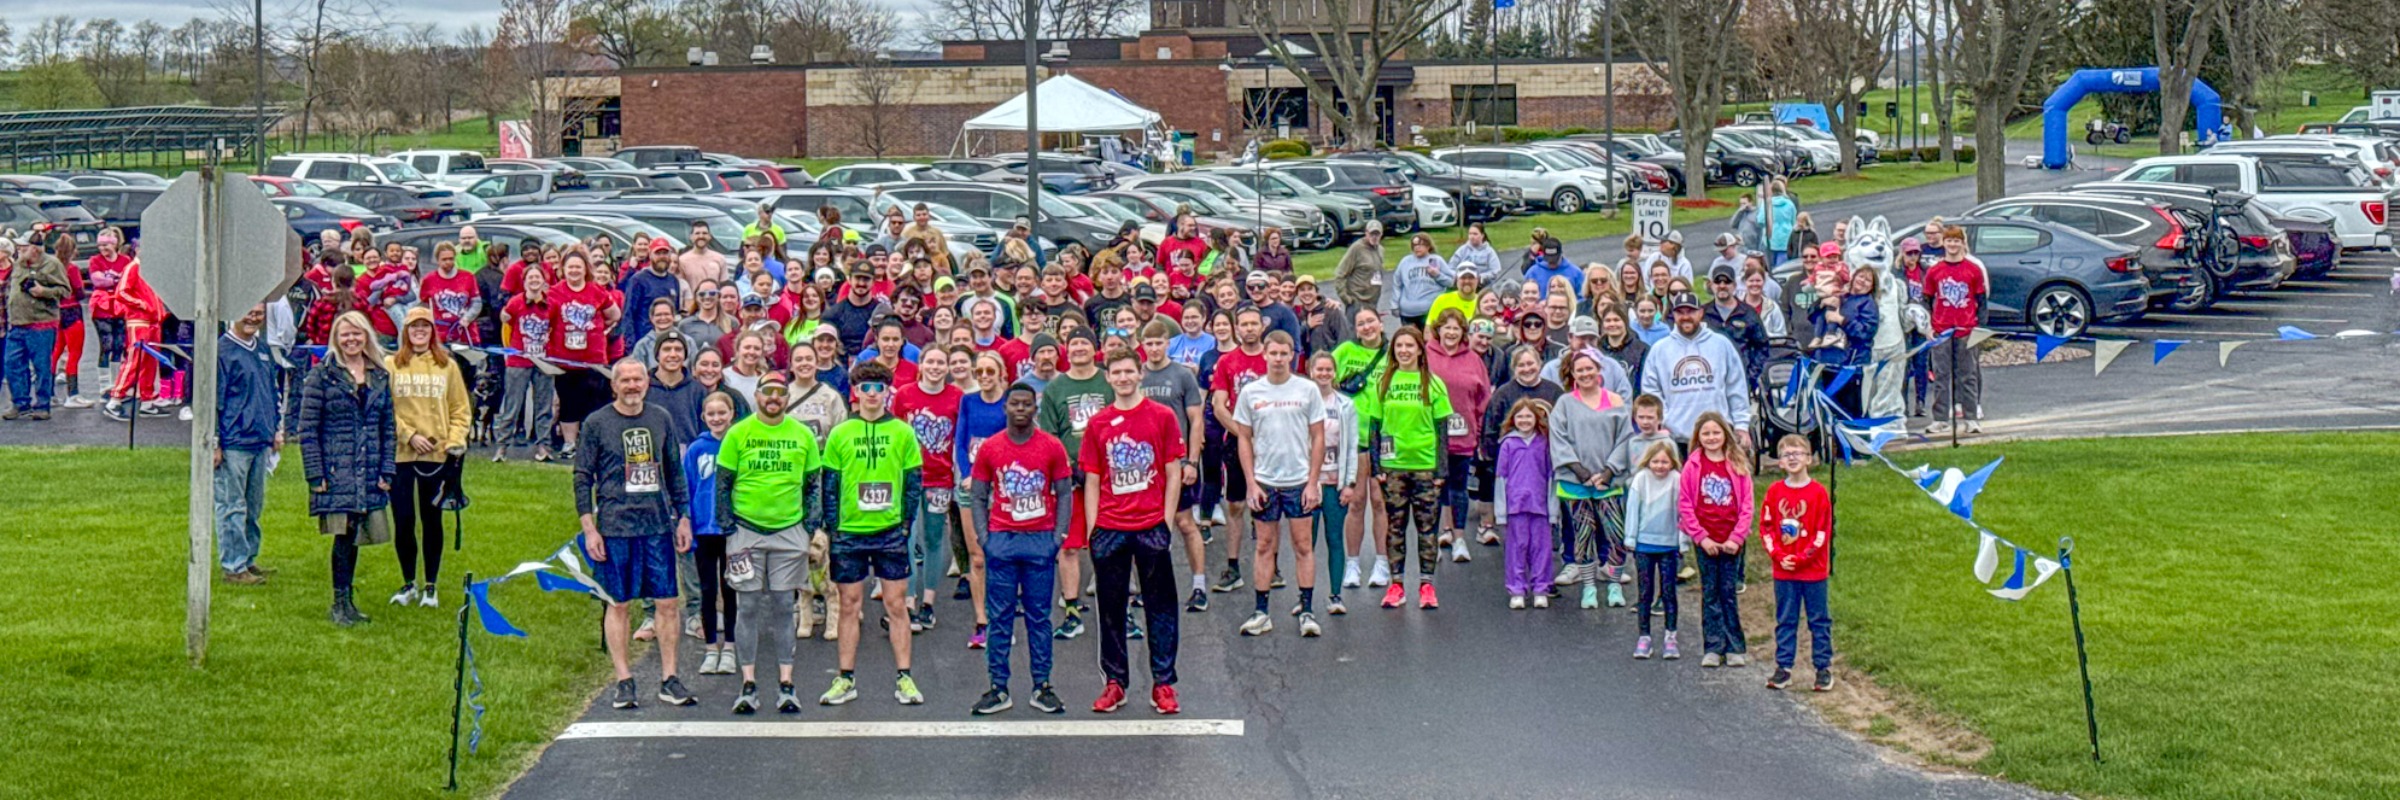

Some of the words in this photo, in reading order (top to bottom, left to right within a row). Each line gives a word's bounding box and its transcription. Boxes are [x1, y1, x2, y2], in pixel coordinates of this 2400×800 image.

[1636, 198, 1668, 207] SPEED
[1639, 220, 1664, 240] 10
[1671, 374, 1714, 387] dance
[625, 435, 648, 446] VET
[745, 439, 798, 449] ADMINISTER
[759, 450, 781, 460] MEDS
[630, 470, 656, 484] 4345
[1115, 469, 1140, 486] 4269
[863, 489, 888, 503] 4337
[1016, 494, 1042, 512] 4266
